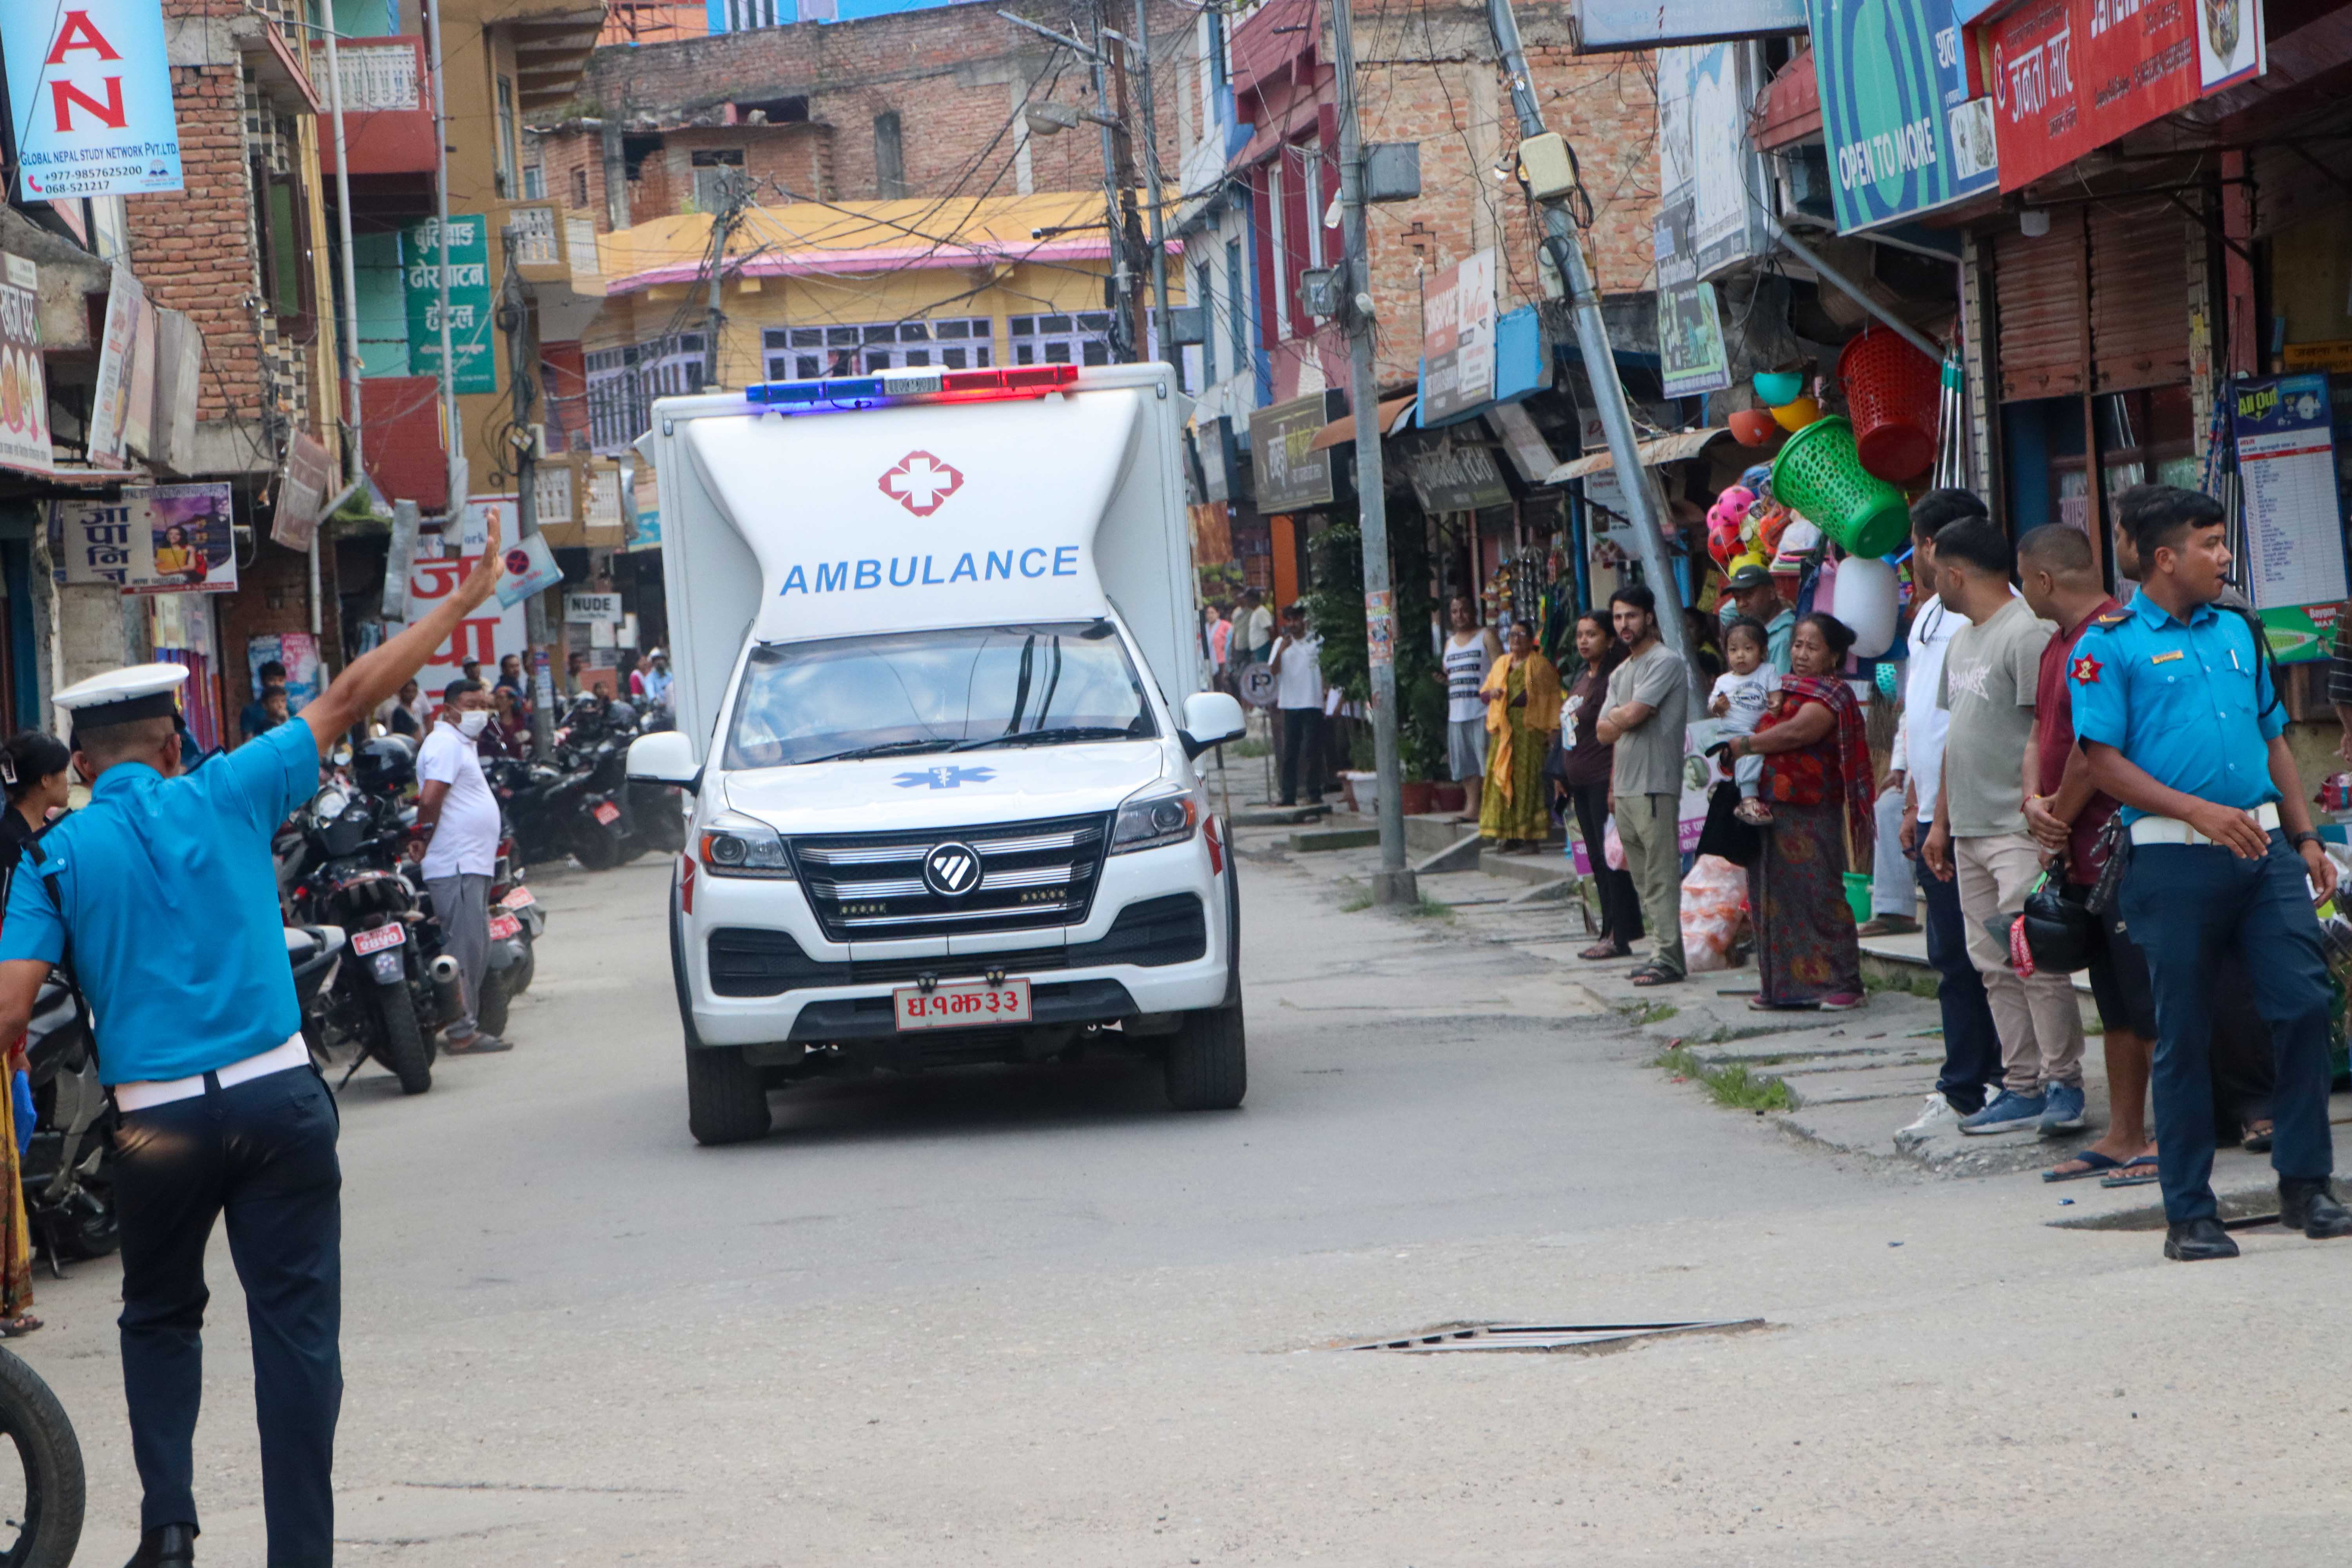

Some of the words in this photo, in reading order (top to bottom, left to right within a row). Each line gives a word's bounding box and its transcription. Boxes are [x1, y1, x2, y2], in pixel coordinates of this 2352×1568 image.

[21, 152, 52, 165] GLOBAL
[54, 149, 79, 163] NEPAL
[81, 147, 104, 161] STUDY
[106, 144, 143, 160] NETWORK
[1838, 141, 1877, 191] OPEN
[1873, 132, 1896, 179] TO
[1895, 117, 1936, 173] MORE
[45, 165, 142, 181] +977-9857625200
[45, 181, 110, 194] 068-521217
[779, 545, 1080, 597] AMBULANCE
[572, 597, 611, 611] NUDE
